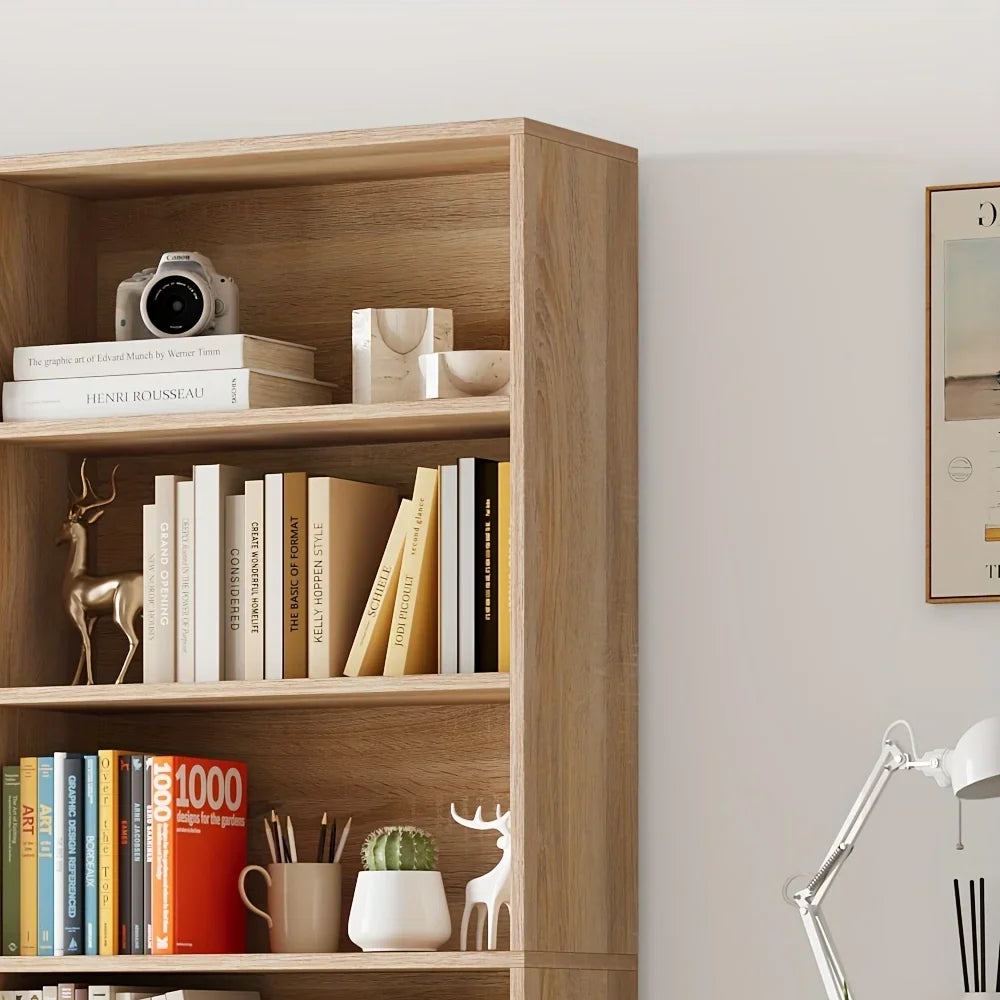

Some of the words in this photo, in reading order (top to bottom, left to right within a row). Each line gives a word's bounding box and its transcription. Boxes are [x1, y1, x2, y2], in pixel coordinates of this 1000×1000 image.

[28, 358, 42, 366] The
[44, 356, 72, 367] graphic
[74, 356, 84, 364] art
[86, 354, 94, 363] of
[97, 352, 124, 362] Edvard
[127, 351, 153, 361] Munch
[155, 350, 165, 361] by
[168, 349, 195, 358] Werner
[86, 392, 128, 405] HENRI
[133, 388, 204, 402] ROUSSEAU
[160, 522, 168, 565] GRAND
[290, 516, 298, 559] FORMAT
[314, 522, 323, 556] STYLE
[410, 527, 420, 555] second
[415, 497, 425, 525] glance
[230, 548, 239, 631] CONSIDERED
[290, 562, 298, 576] OF
[314, 560, 323, 605] HOPPEN
[160, 570, 168, 626] OPENING
[290, 580, 298, 609] BASIC
[368, 565, 391, 618] SCHIELE
[399, 574, 414, 620] PICOULT
[290, 612, 298, 632] THE
[314, 608, 323, 642] KELLY
[394, 622, 405, 647] JODI
[68, 775, 76, 817] GRAPHIC
[153, 763, 172, 823] 1000
[175, 764, 243, 812] 1000
[22, 805, 34, 835] ART
[40, 804, 52, 835] ART
[68, 819, 76, 854] DESIGN
[176, 811, 200, 826] designs
[201, 812, 210, 824] for
[211, 813, 221, 825] the
[86, 836, 94, 886] BORDEAUX
[68, 857, 76, 918] REFERENCED
